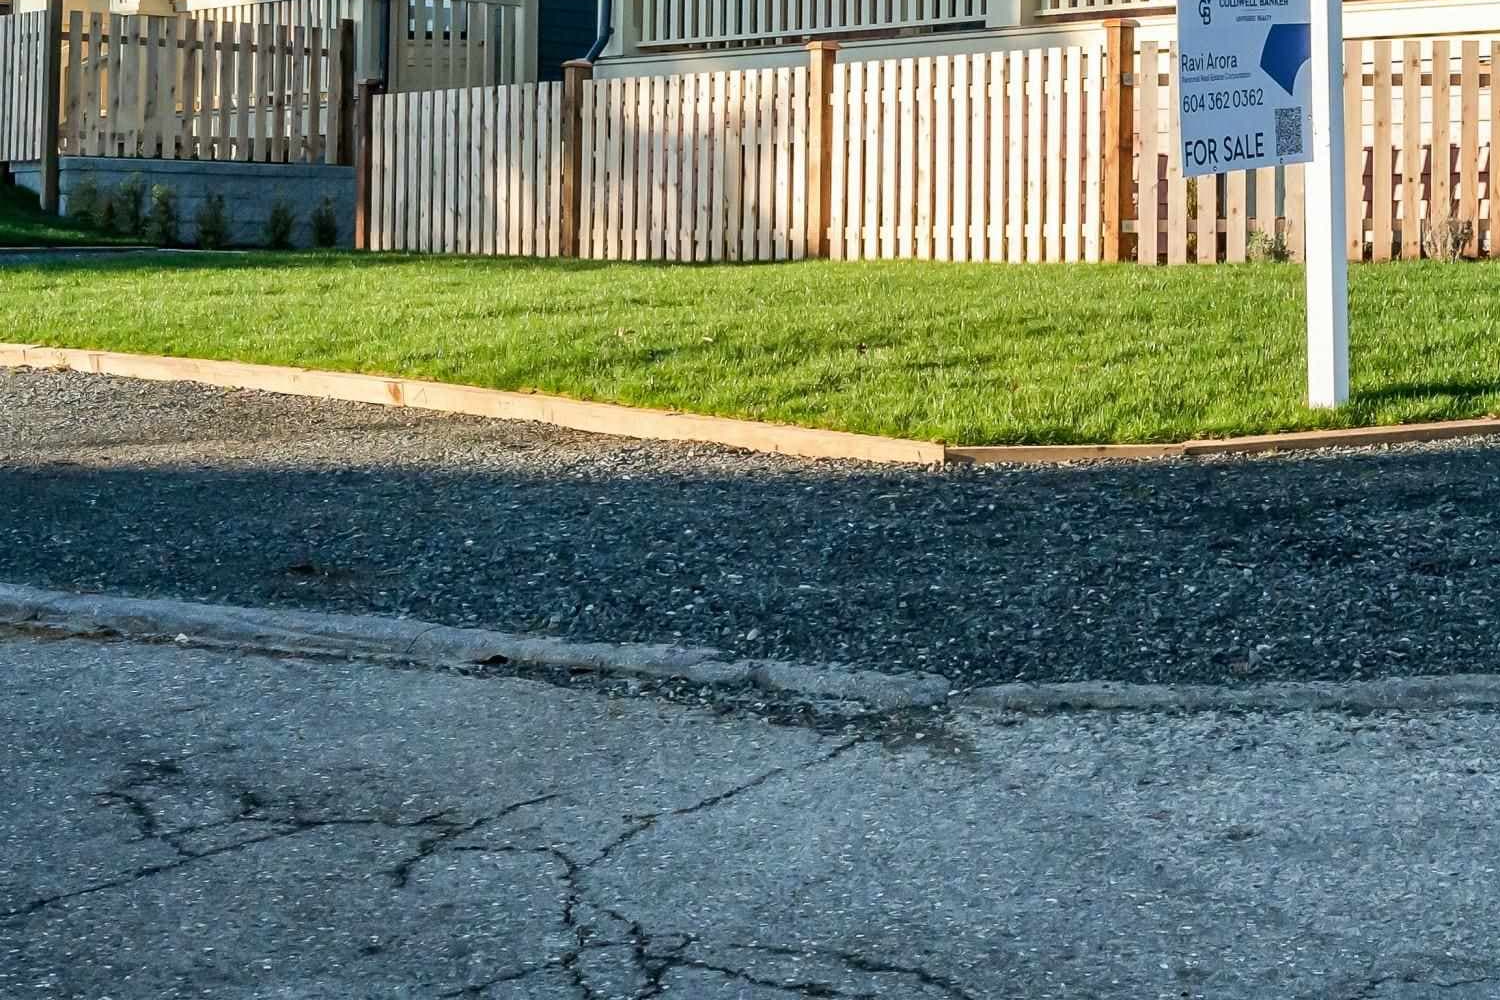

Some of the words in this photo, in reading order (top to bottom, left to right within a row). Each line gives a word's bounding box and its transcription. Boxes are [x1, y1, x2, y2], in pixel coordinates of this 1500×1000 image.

[1181, 53, 1204, 73] Ravi
[1206, 52, 1238, 70] Arora
[1183, 94, 1205, 113] 604
[1208, 90, 1230, 110] 362
[1232, 88, 1264, 108] 0362
[1184, 137, 1218, 168] FOR
[1223, 132, 1265, 161] SALE
